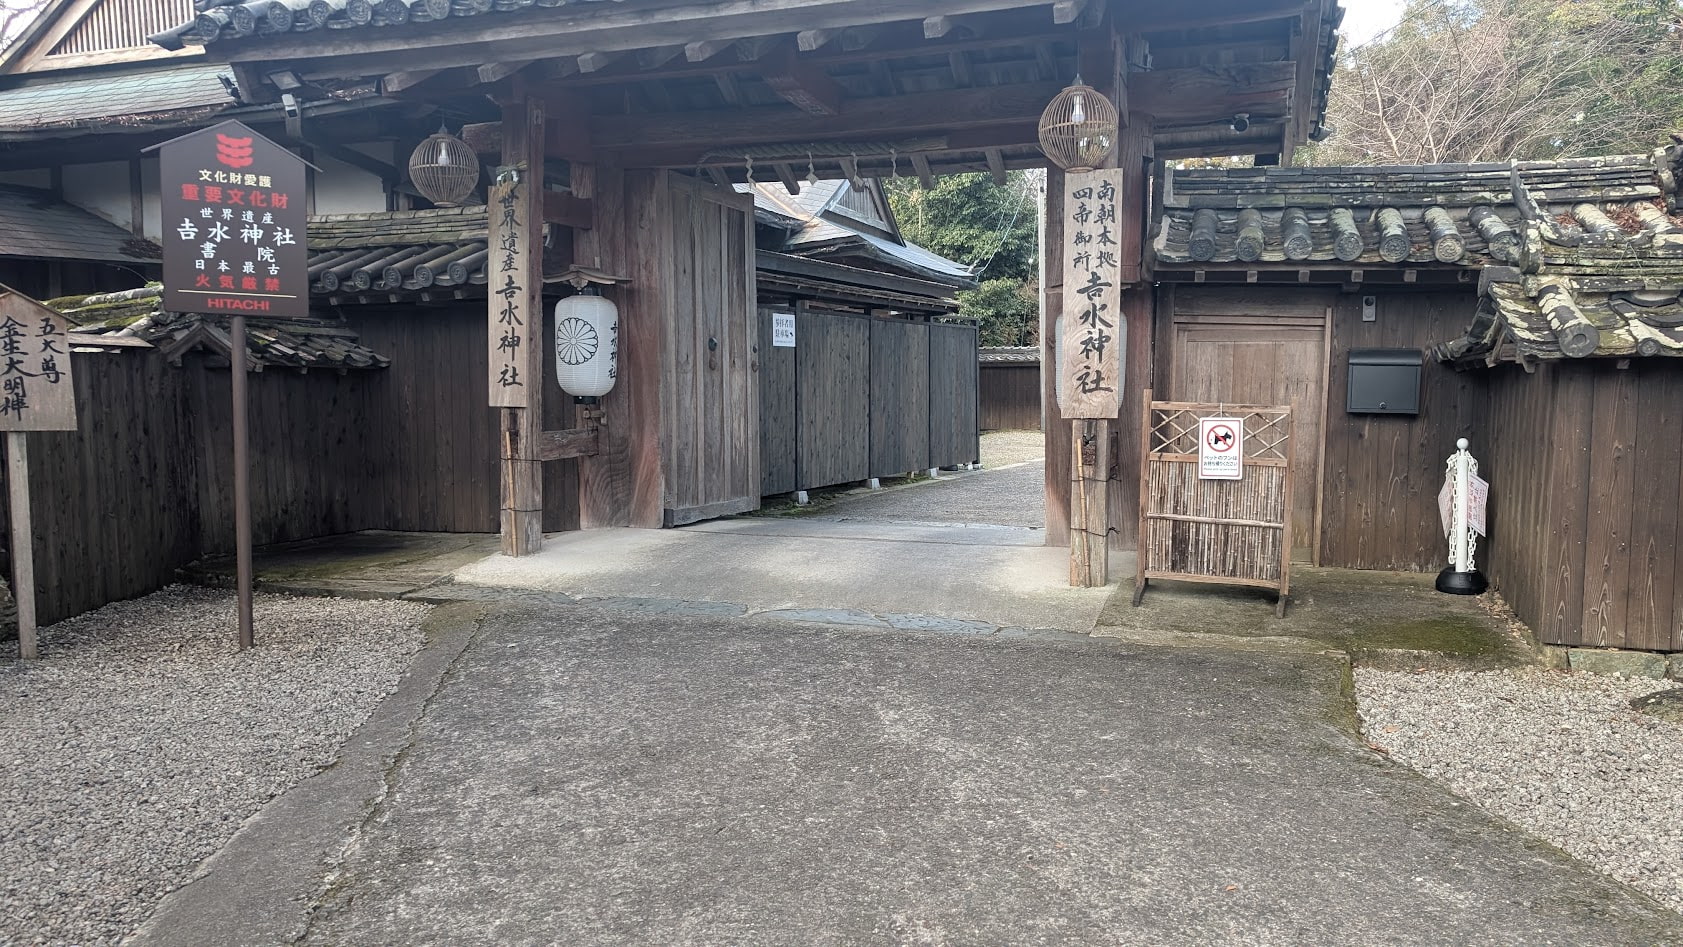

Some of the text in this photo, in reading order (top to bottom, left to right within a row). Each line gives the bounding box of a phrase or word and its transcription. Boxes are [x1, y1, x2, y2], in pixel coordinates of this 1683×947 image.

[199, 169, 272, 188] 文化財愛護
[181, 183, 289, 209] 重要文化財
[200, 207, 274, 225] 世界遺産
[1072, 186, 1093, 273] 四帝御所
[195, 259, 280, 275] 日本最古
[195, 273, 280, 292] 火気厳禁
[207, 298, 270, 310] HITACHI
[35, 317, 66, 384] 五大尊
